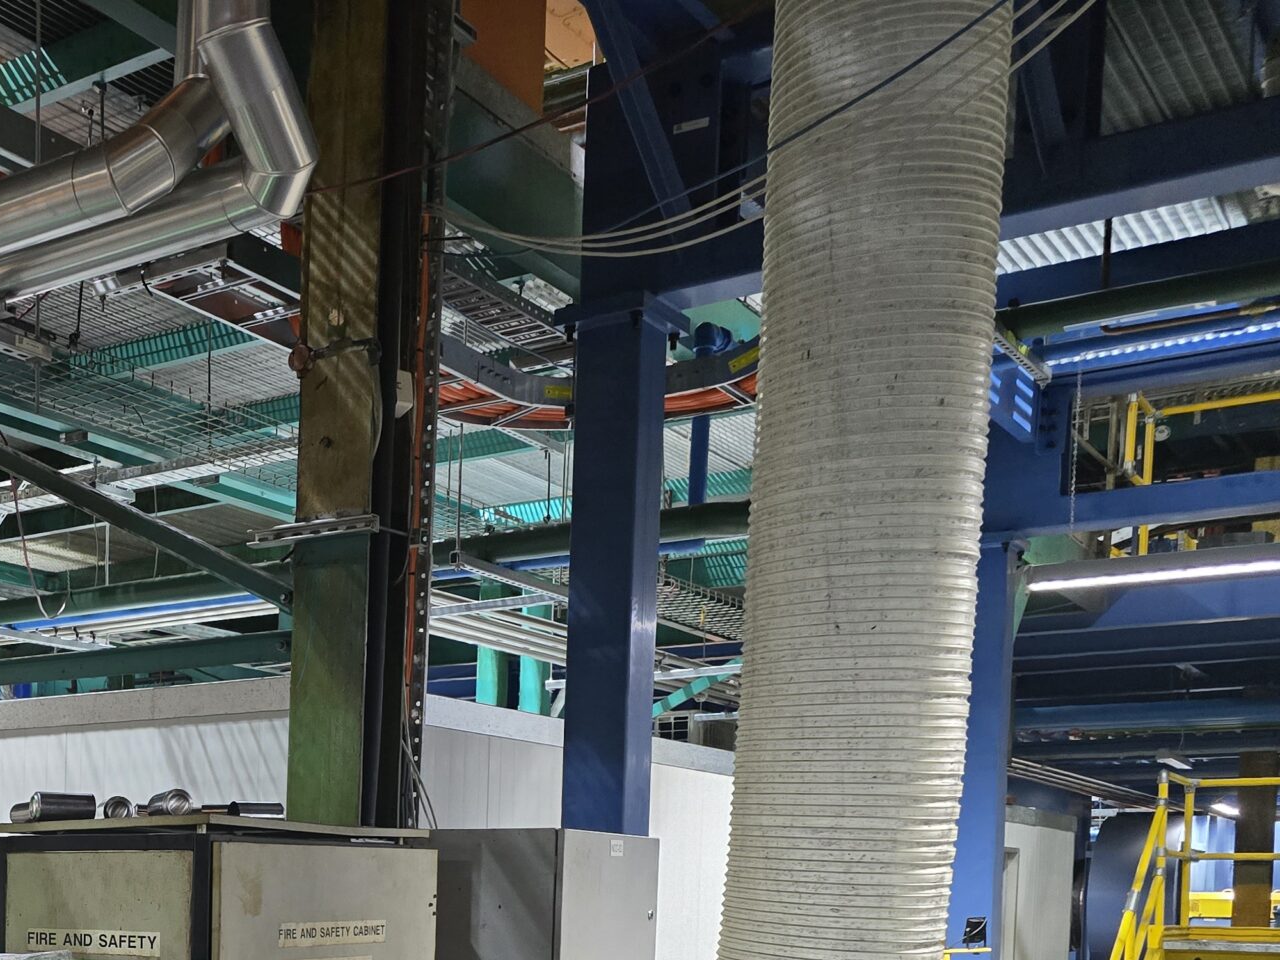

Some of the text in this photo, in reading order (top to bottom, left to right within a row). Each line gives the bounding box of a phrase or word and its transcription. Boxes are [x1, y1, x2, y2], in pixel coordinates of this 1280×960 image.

[27, 931, 157, 949] FIRE AND SAFETY
[279, 924, 385, 940] FIRE AND SAFETY CABINET
